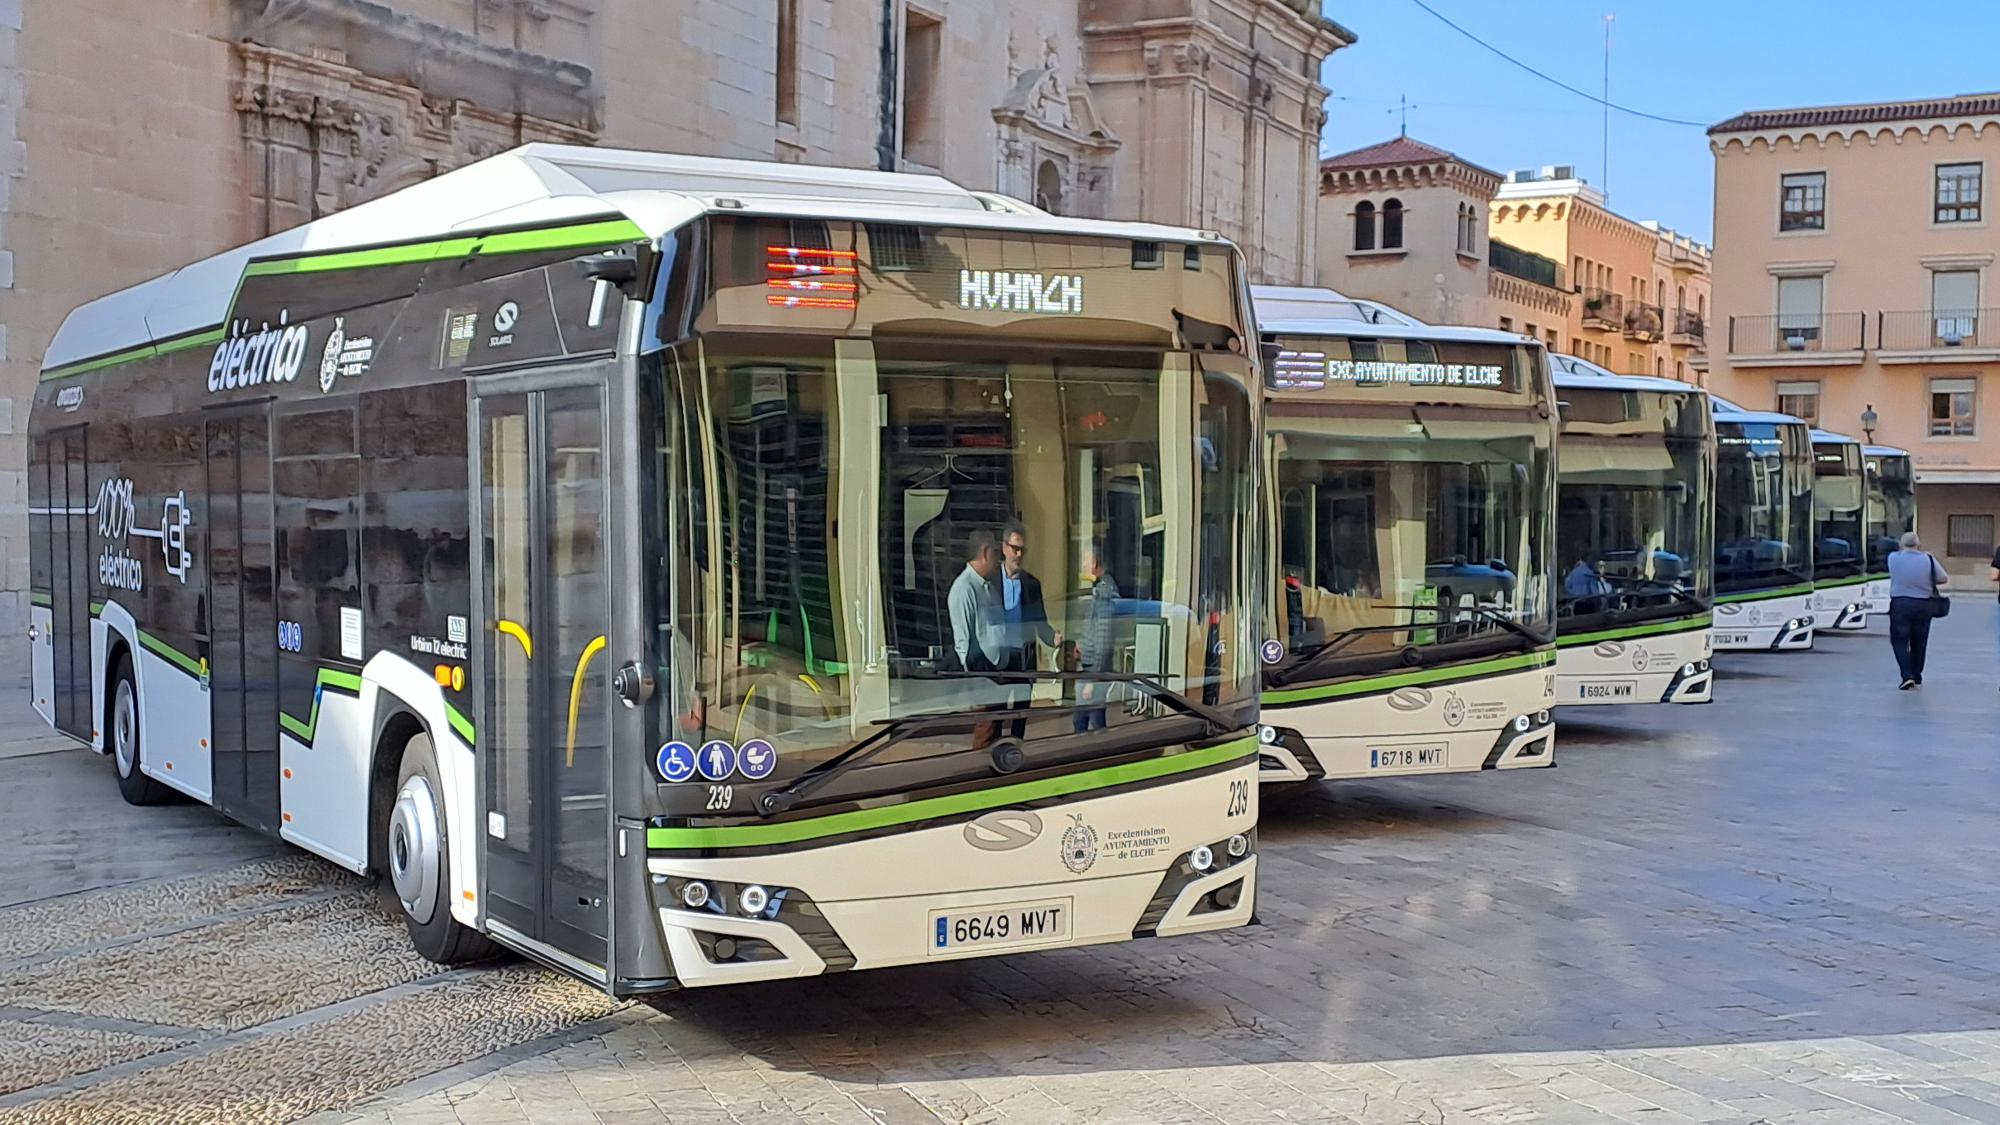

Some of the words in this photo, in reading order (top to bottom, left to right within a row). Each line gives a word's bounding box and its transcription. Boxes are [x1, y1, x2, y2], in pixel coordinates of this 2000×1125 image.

[207, 309, 309, 393] eléctrico
[1448, 364, 1463, 384] DE
[1466, 365, 1502, 385] ELCHE
[98, 479, 134, 541] 100%
[100, 544, 142, 591] eléctrico
[410, 634, 432, 653] Urbino
[433, 638, 442, 655] 12
[441, 641, 467, 660] electric
[1587, 685, 1610, 697] 6924
[1614, 685, 1632, 696] MVW
[1381, 750, 1413, 766] 6718
[1419, 749, 1442, 764] MVT
[706, 785, 733, 810] 239
[1227, 779, 1249, 817] 239
[1102, 836, 1170, 851] AYUNTAMIENTO
[1118, 850, 1128, 859] de
[1130, 848, 1156, 858] ELCHE
[954, 914, 1010, 942] 6649
[1021, 908, 1061, 935] MVT
